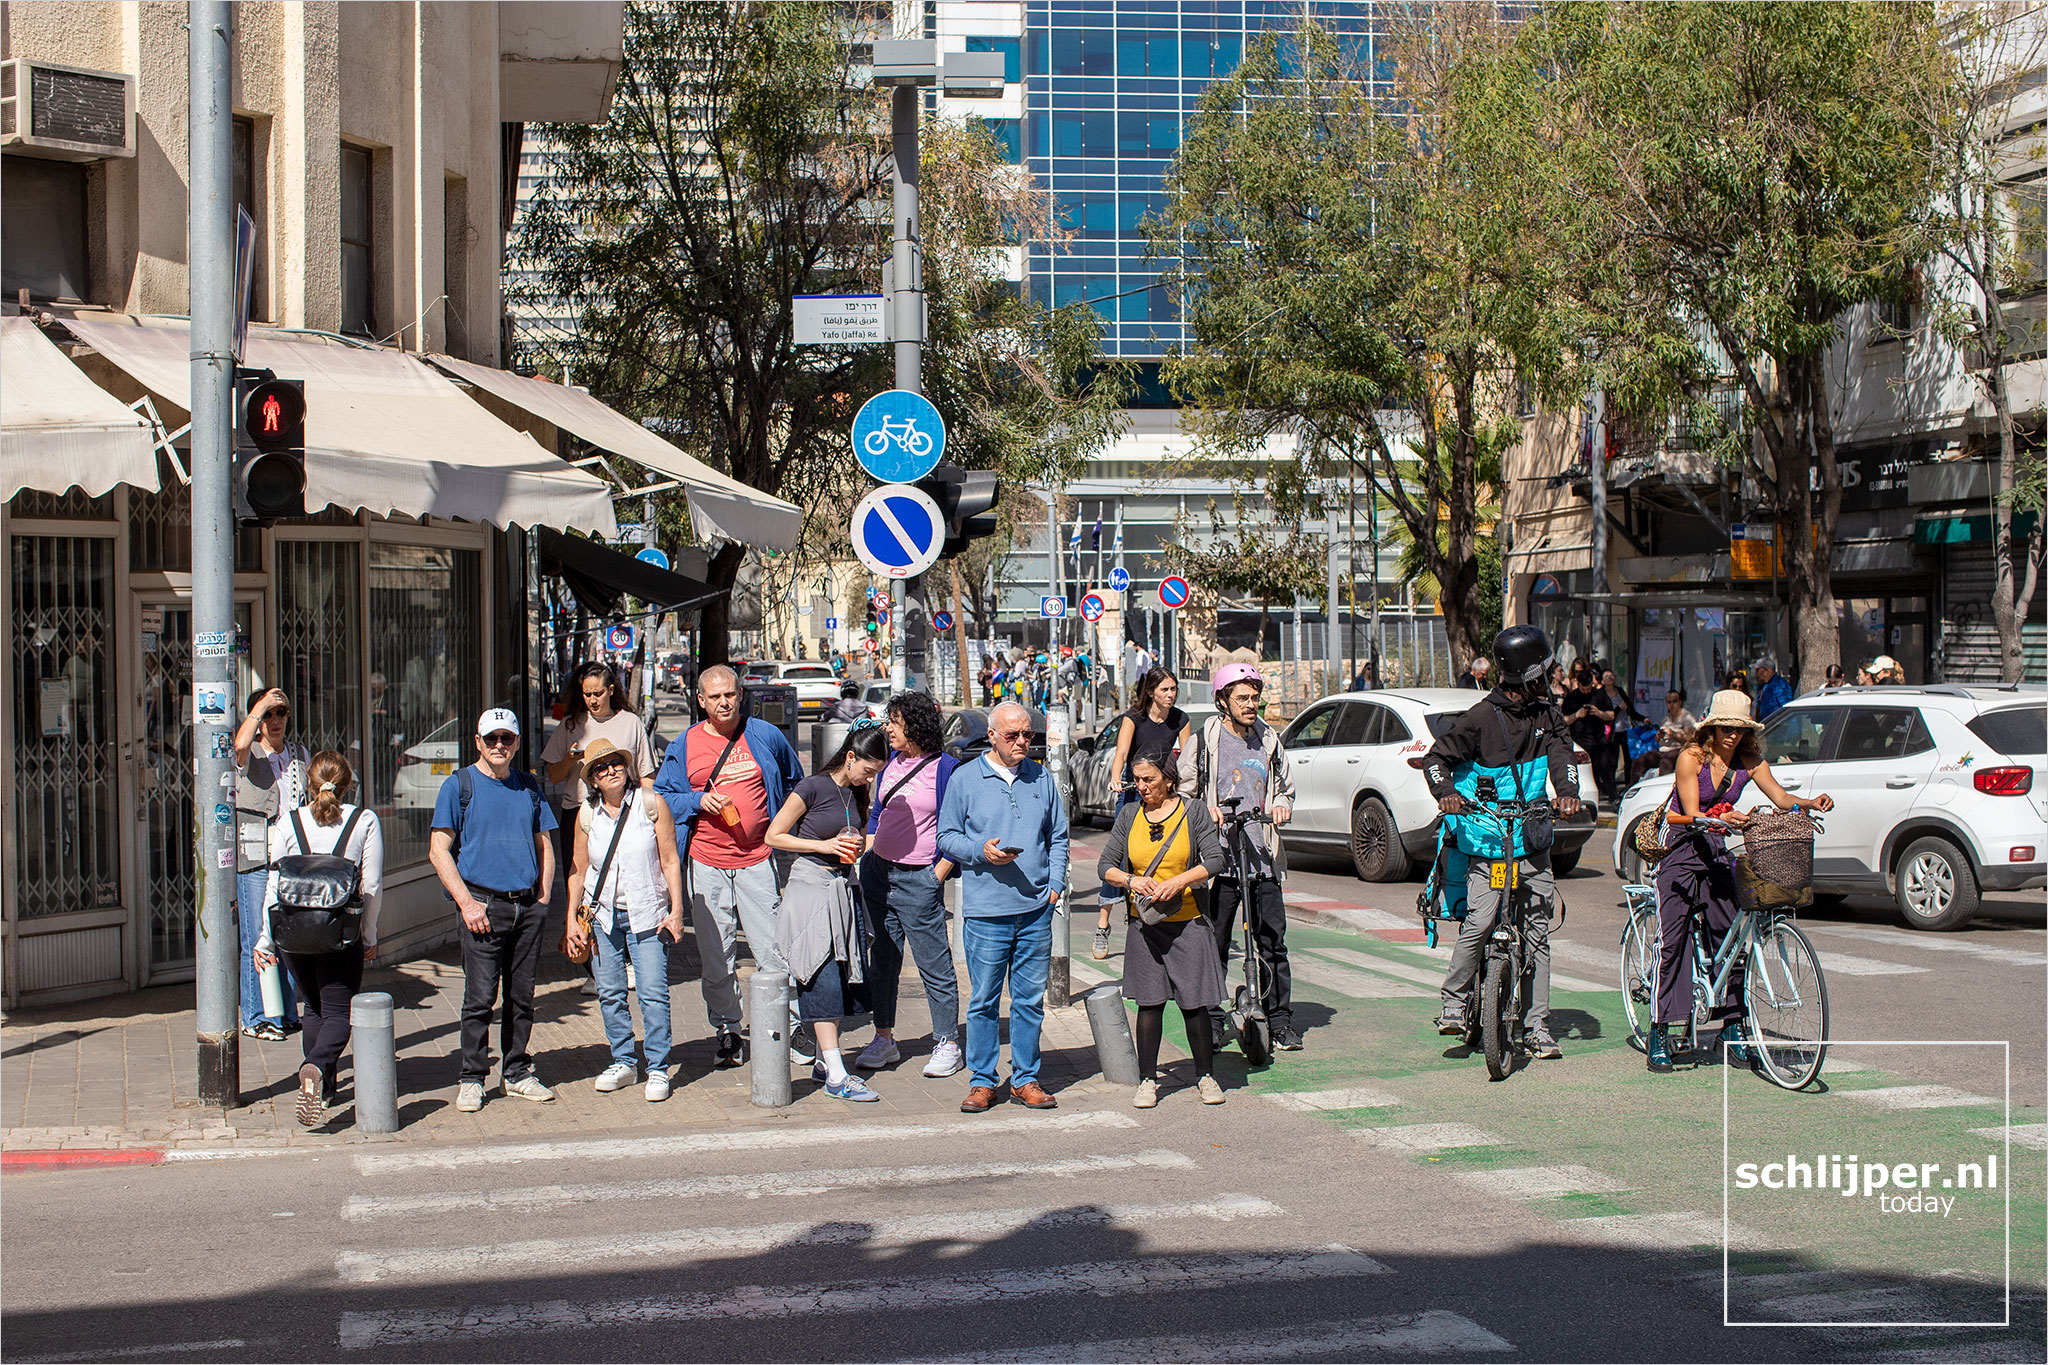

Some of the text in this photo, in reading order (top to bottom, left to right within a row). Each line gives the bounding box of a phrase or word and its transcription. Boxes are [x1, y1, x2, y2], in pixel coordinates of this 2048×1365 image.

[861, 303, 877, 312] דרך
[859, 316, 878, 325] طريق
[822, 331, 840, 339] Yafo
[841, 330, 866, 340] (Jaffa)
[1048, 603, 1060, 612] 30
[613, 632, 626, 642] 30
[494, 711, 504, 720] H
[1494, 876, 1515, 886] 152
